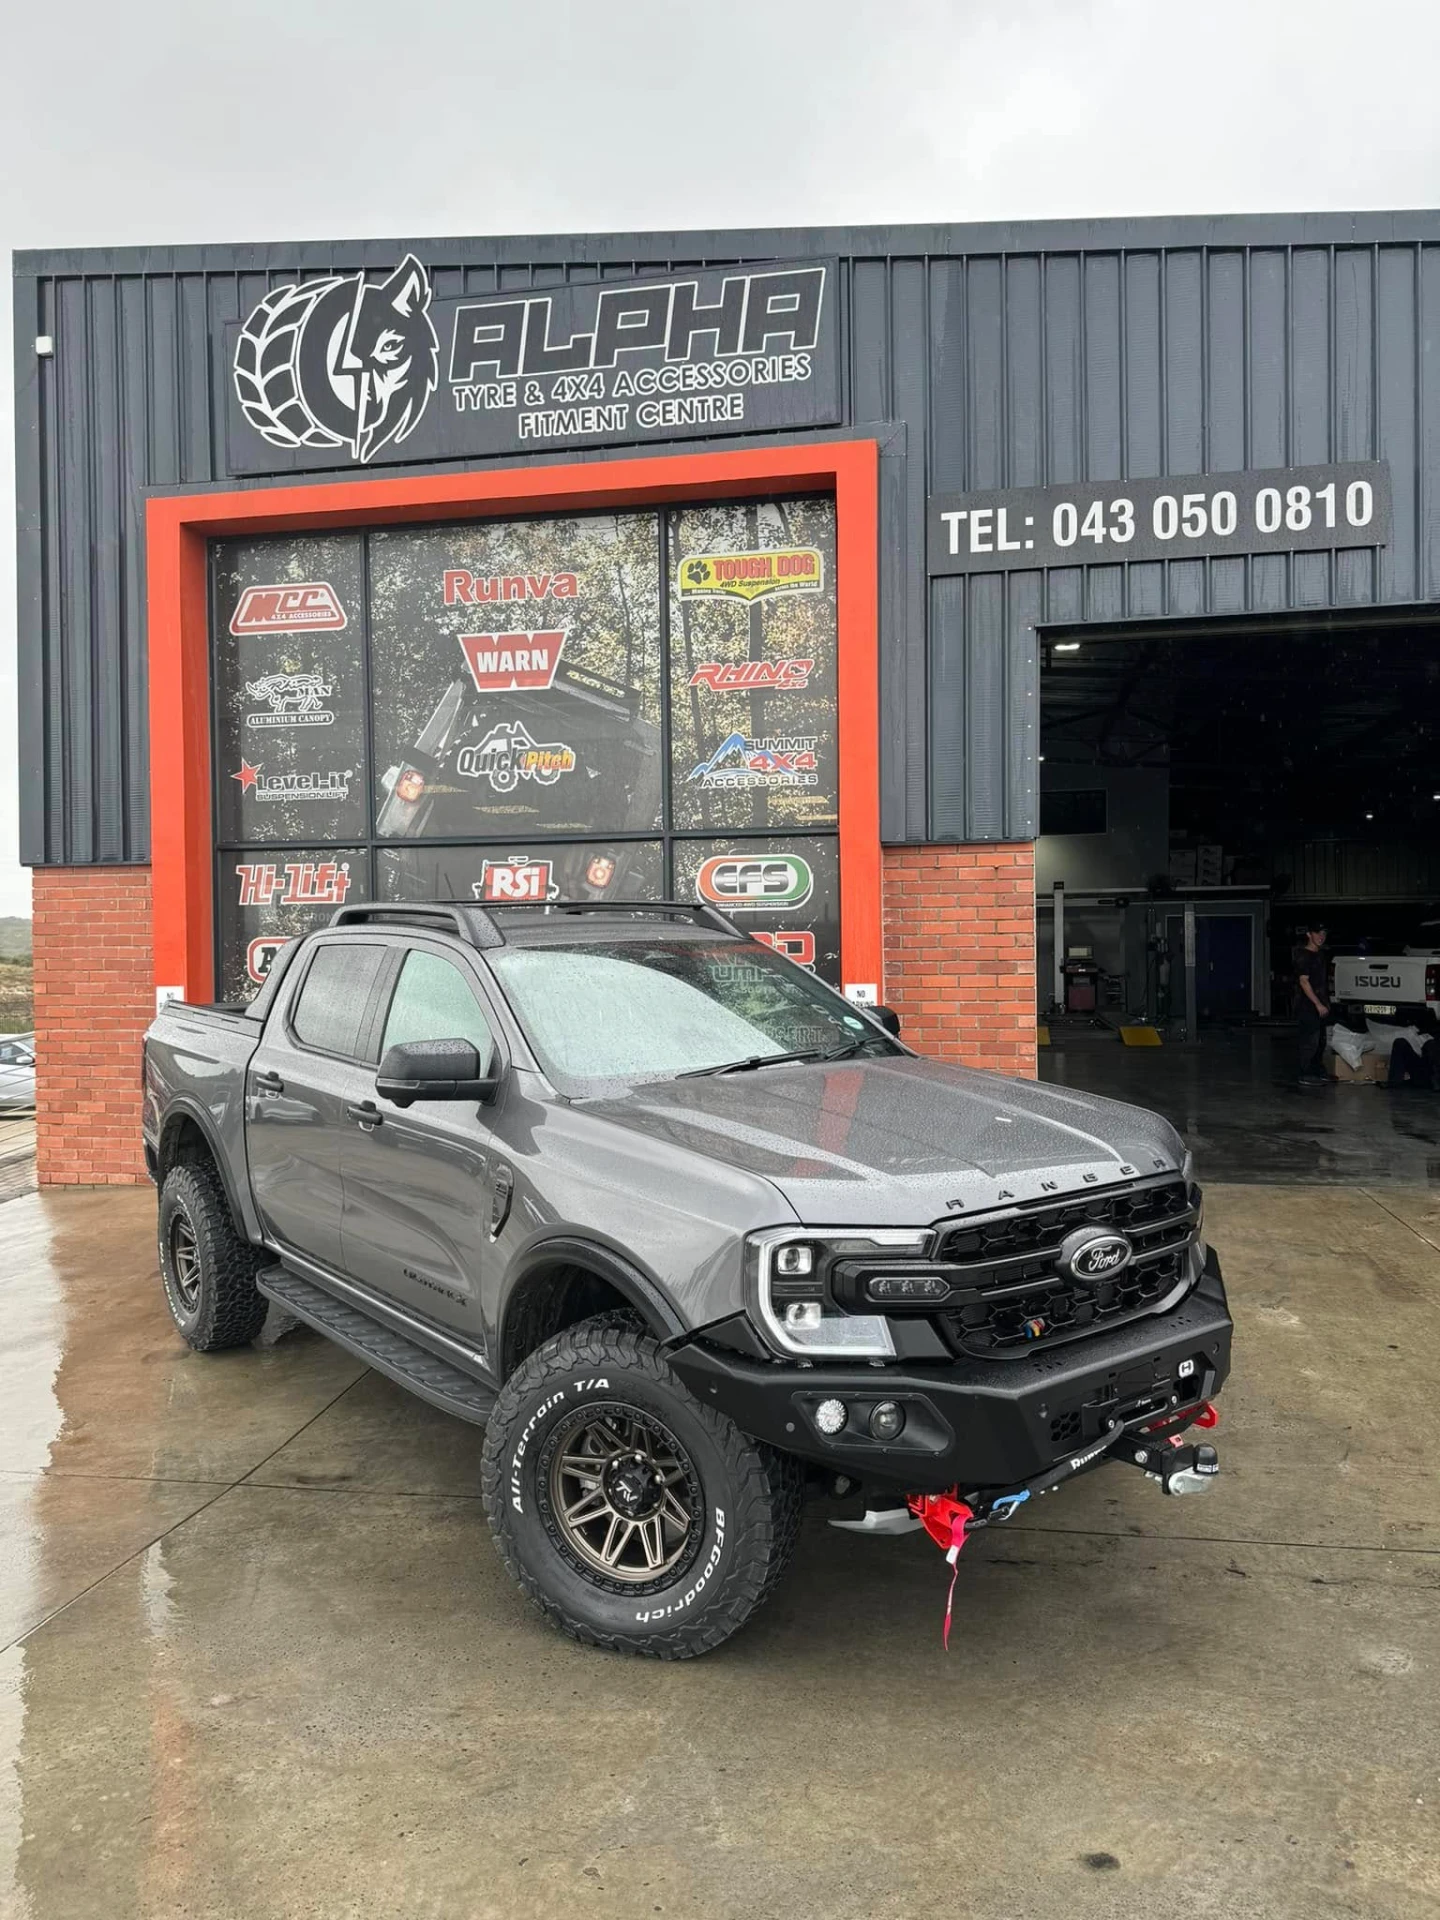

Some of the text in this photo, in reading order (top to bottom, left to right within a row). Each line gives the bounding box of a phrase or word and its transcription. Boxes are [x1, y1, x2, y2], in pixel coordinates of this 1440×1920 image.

[450, 267, 826, 382] ALPHA
[453, 353, 812, 412] TYRE & 4X4 ACCESSORIES
[518, 393, 744, 439] FITMENT CENTRE
[940, 480, 1374, 555] TEL: 043 050 0810
[713, 553, 815, 581] TOUGH DOG
[443, 569, 580, 605] Runva
[241, 590, 332, 622] MCC
[289, 611, 332, 619] ACCESSORIES
[477, 649, 549, 673] WARN
[690, 660, 814, 691] RHINO
[250, 714, 331, 725] ALUMINIUM CANOPY
[744, 737, 817, 751] SUMMIT
[458, 747, 574, 777] Quick Pitch
[749, 752, 817, 770] 4X4
[702, 774, 818, 789] ACCESSORIES
[715, 864, 789, 893] EFS
[856, 990, 865, 998] NO
[1355, 976, 1400, 988] ISUZU
[945, 1157, 1167, 1211] RANGER
[1088, 1247, 1121, 1273] Ford
[509, 1378, 610, 1514] All-Terrain T/A
[635, 1507, 725, 1623] BFGoodrich
